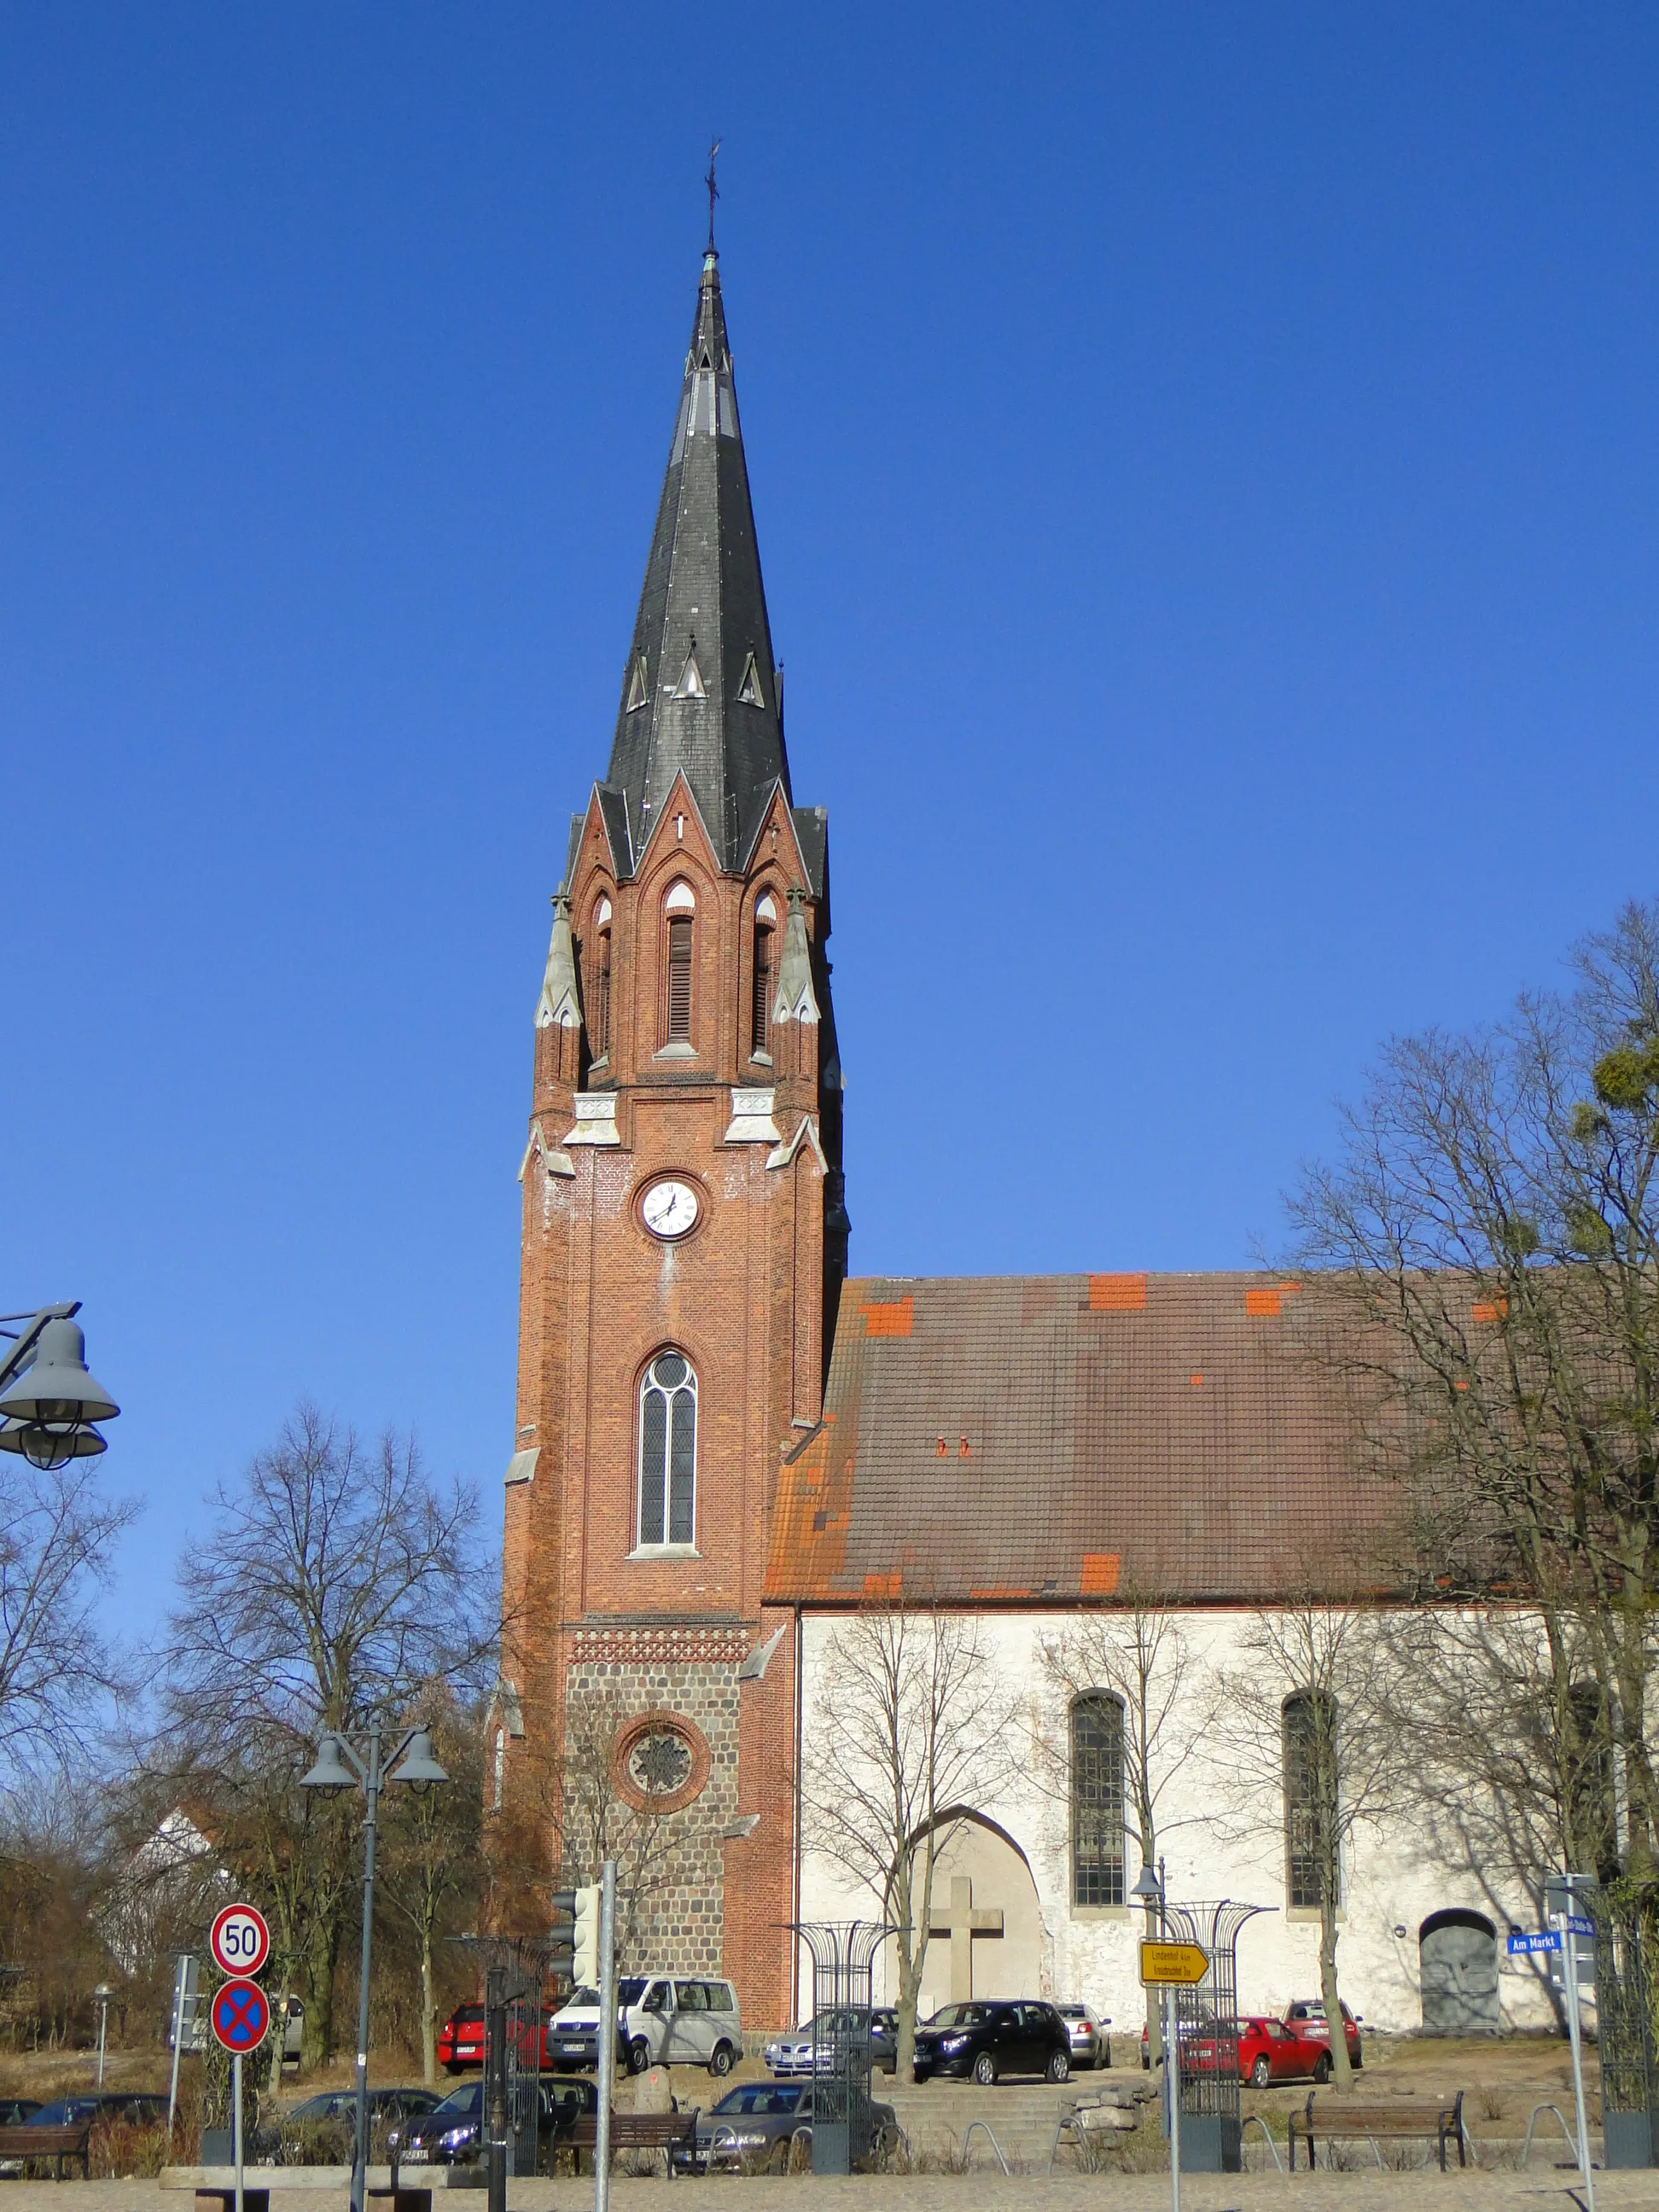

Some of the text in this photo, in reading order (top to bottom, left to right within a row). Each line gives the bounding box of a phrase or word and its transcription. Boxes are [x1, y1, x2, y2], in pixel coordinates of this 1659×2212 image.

[225, 1924, 256, 1956] 50
[1513, 1936, 1555, 1951] Am Markt
